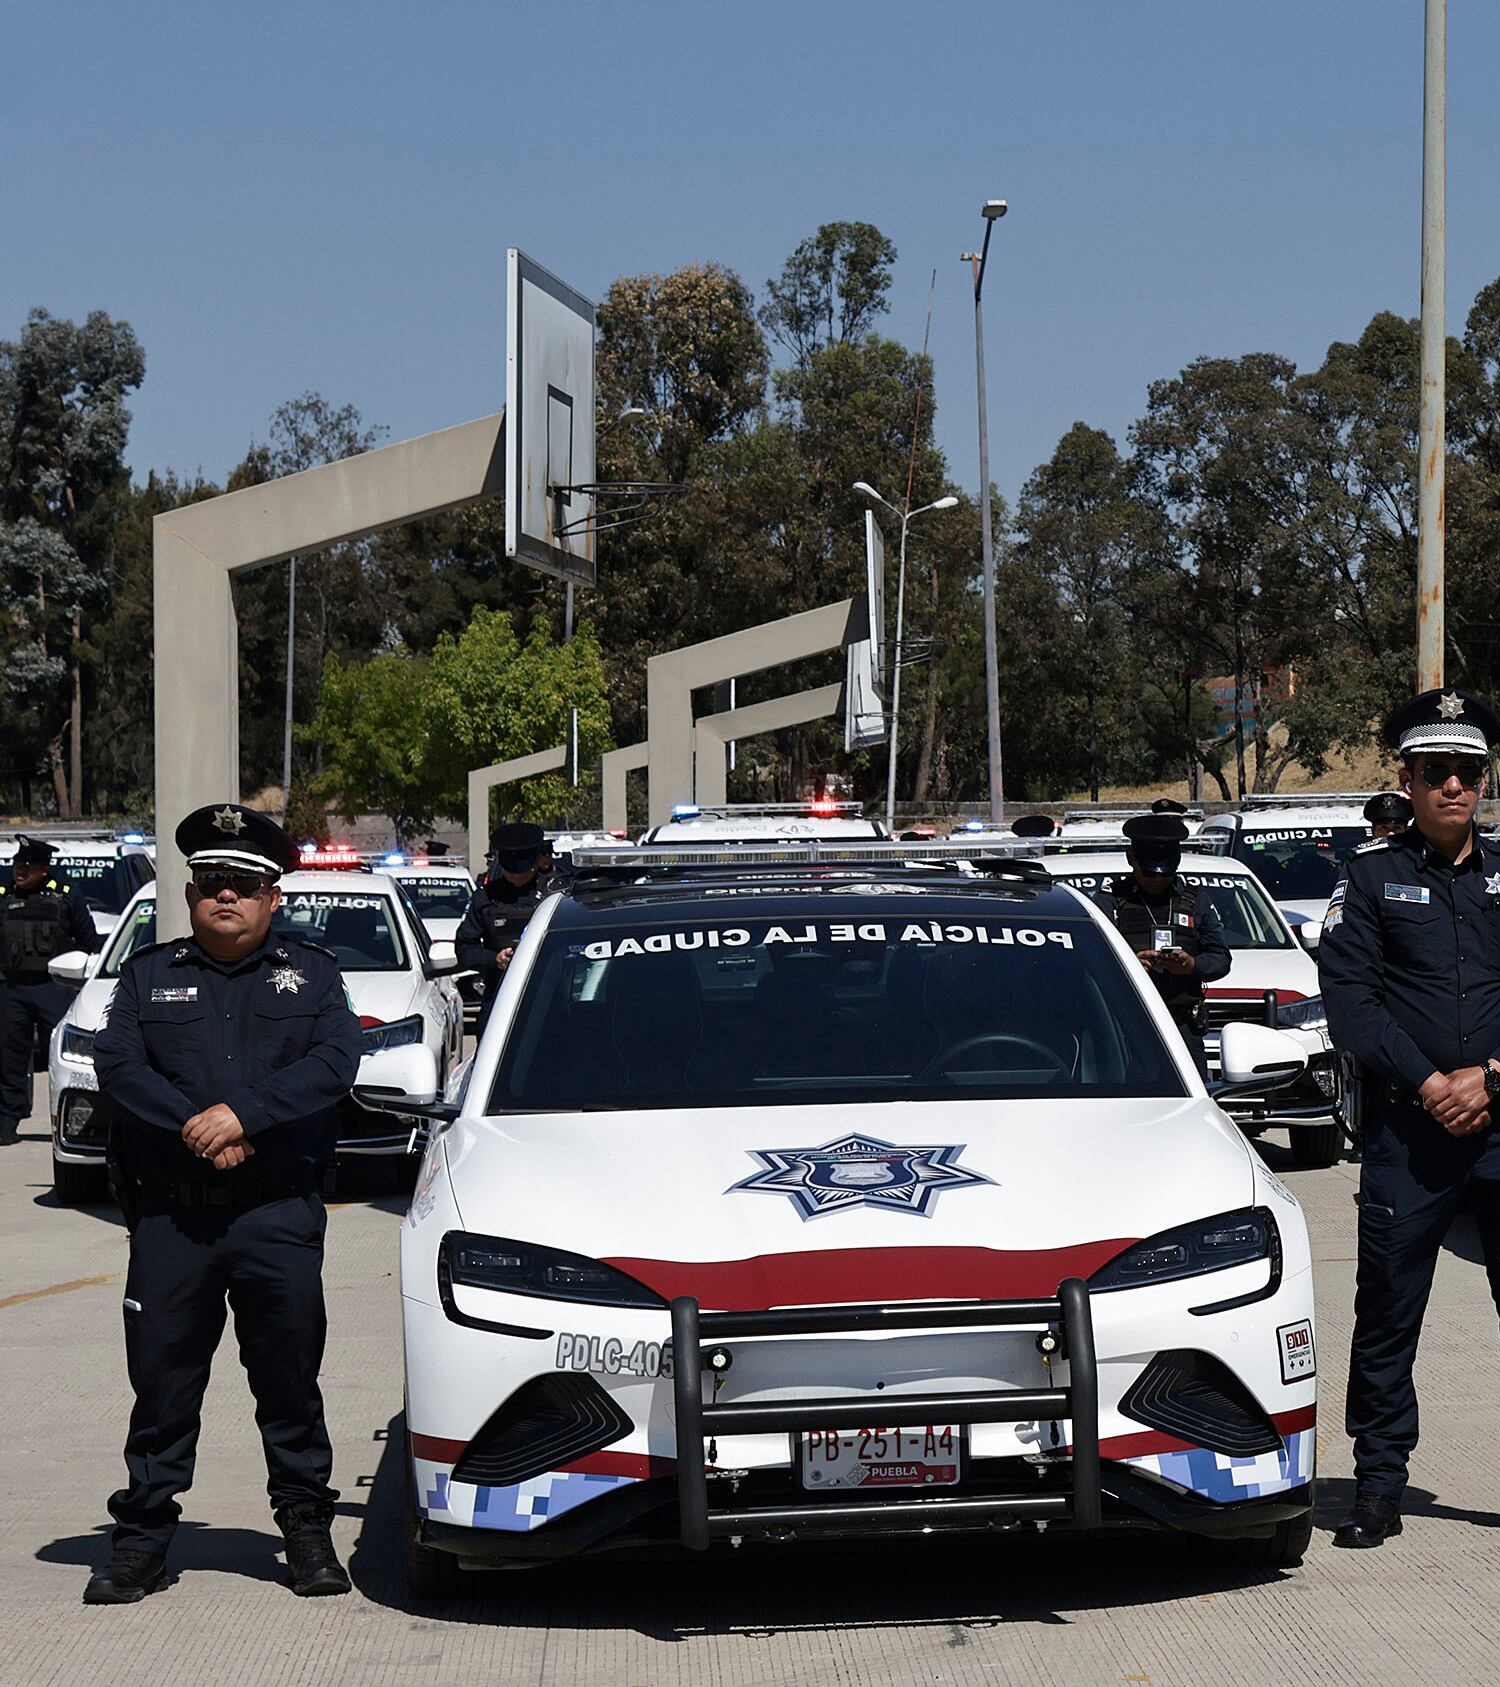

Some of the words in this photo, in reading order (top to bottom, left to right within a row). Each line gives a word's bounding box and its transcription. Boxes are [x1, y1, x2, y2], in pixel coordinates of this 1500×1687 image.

[1287, 1330, 1308, 1348] 911
[556, 1332, 674, 1379] PDLC-405
[808, 1424, 953, 1462] PB-251-A4
[871, 1466, 918, 1477] PUEBLA
